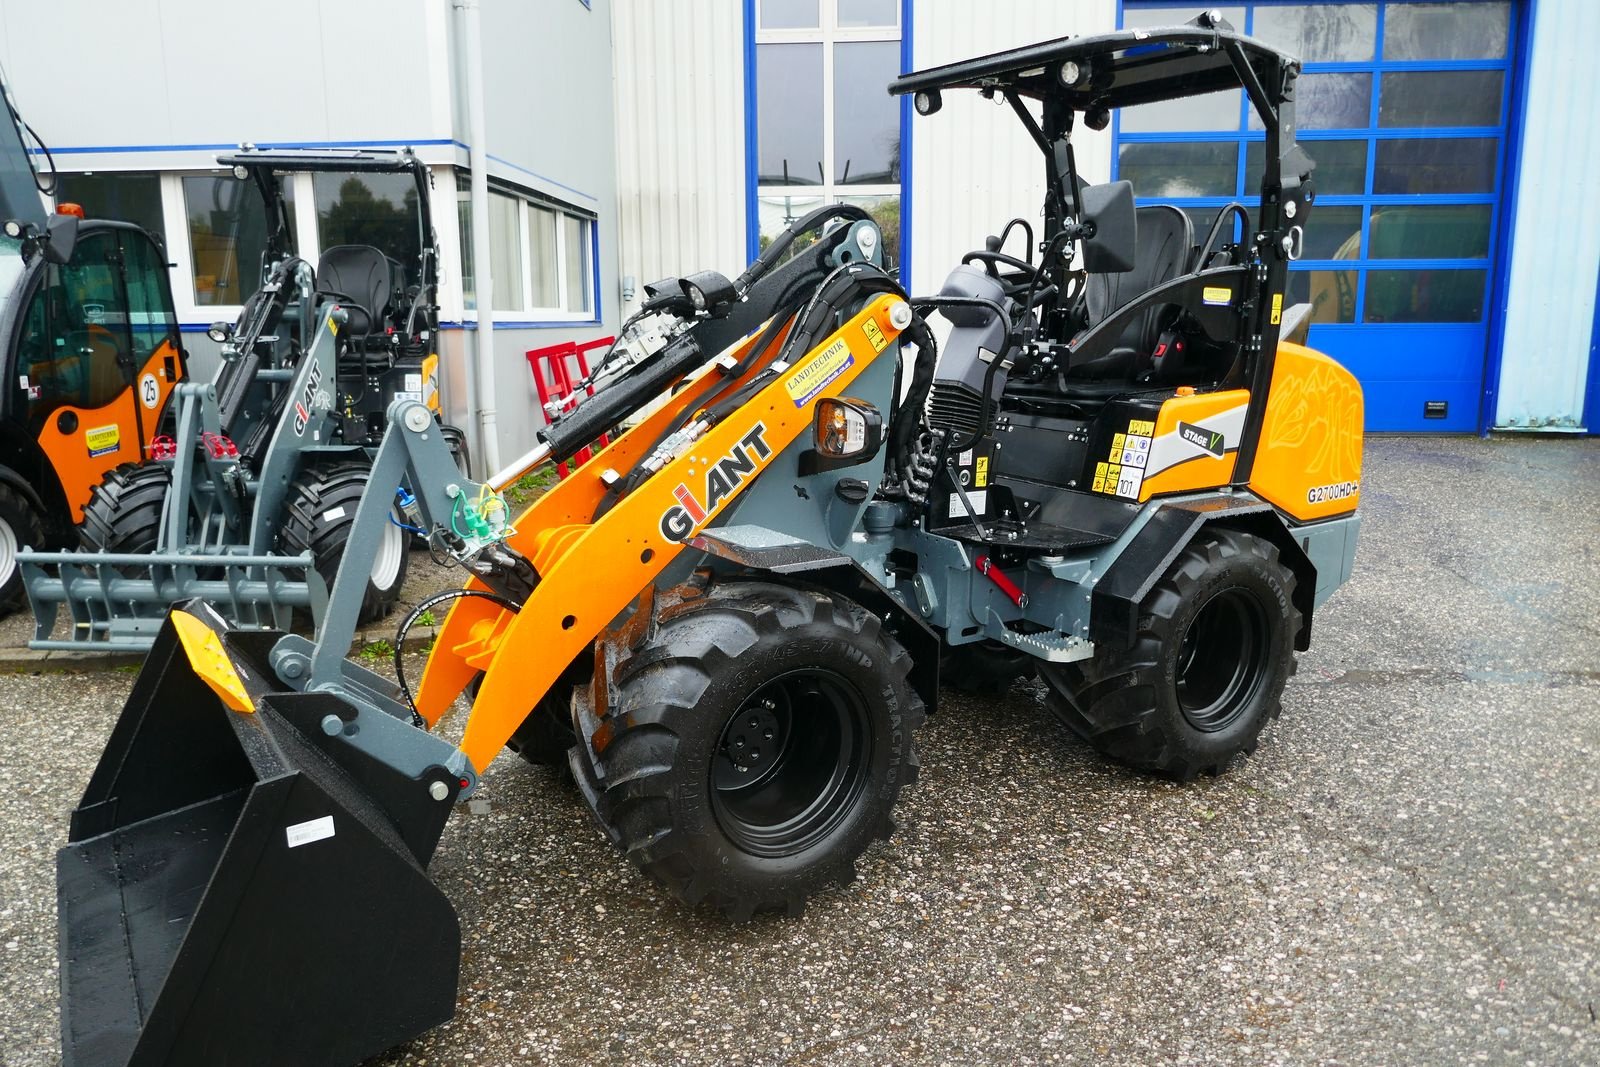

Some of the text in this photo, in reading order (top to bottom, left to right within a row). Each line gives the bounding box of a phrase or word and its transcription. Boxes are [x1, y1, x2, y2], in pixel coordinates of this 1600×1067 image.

[787, 341, 844, 390] LANDTECHNIK
[144, 380, 156, 401] 25
[1183, 429, 1223, 450] STAGE V
[1119, 479, 1133, 496] 101
[1308, 482, 1358, 503] G2700HD+
